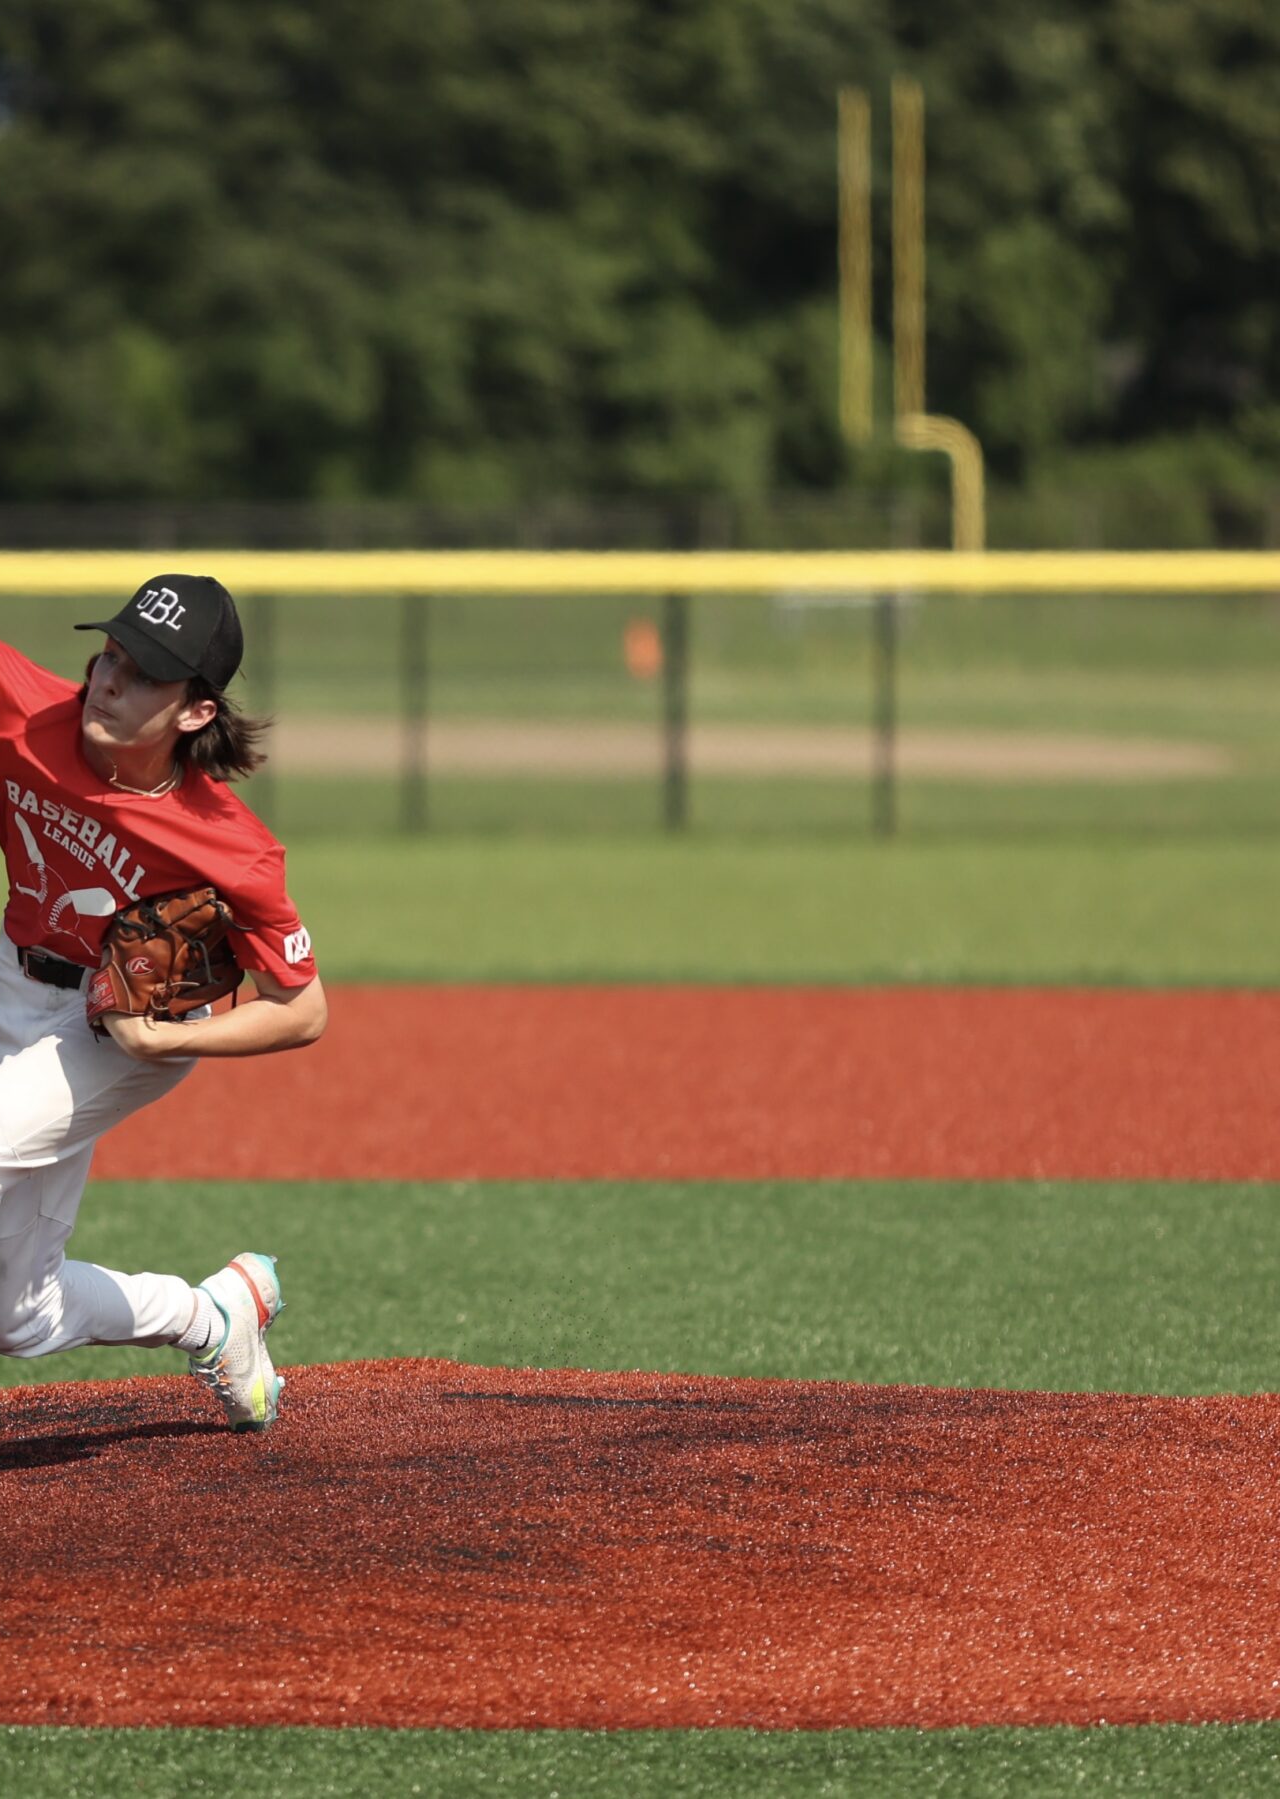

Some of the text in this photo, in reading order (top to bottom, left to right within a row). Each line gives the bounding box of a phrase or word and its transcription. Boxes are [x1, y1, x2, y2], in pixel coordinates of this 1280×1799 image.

[136, 587, 186, 631] UBL
[6, 779, 146, 901] BASEBALL
[43, 821, 97, 871] LEAGUE
